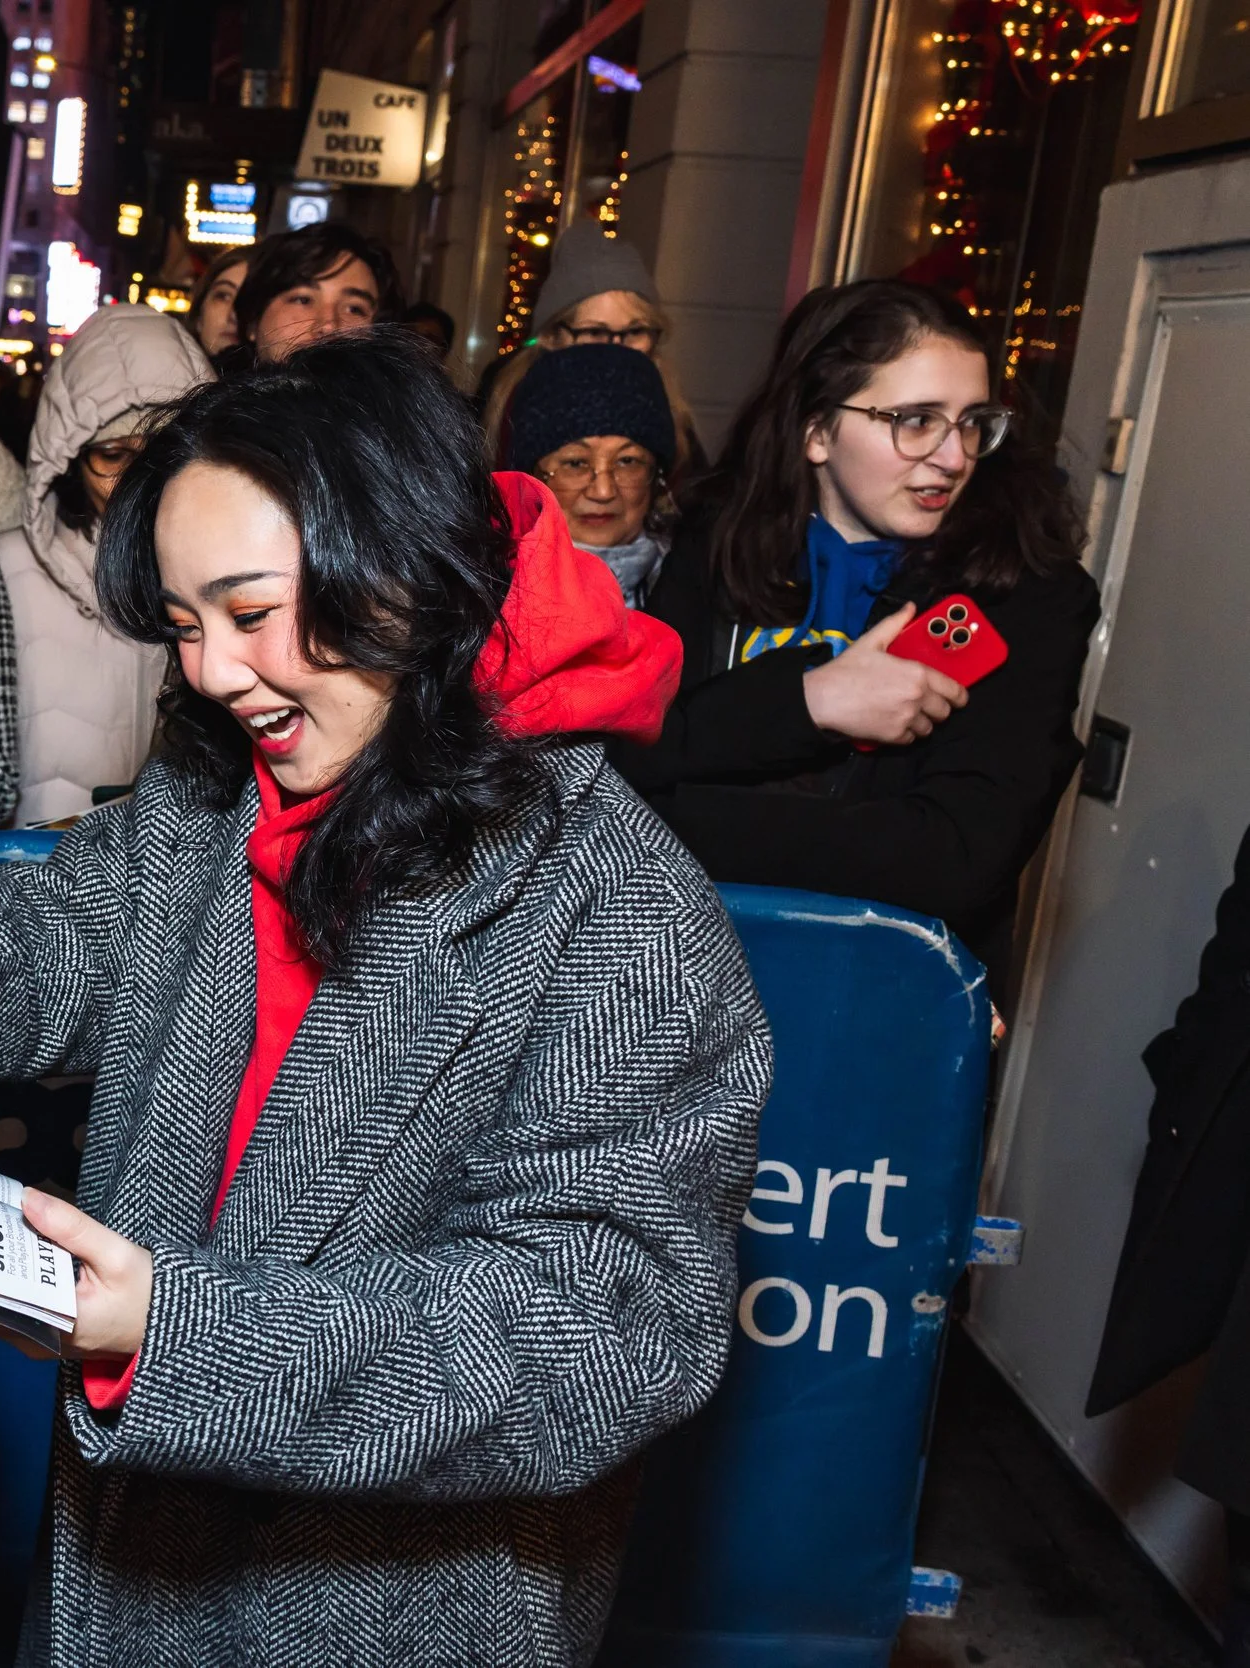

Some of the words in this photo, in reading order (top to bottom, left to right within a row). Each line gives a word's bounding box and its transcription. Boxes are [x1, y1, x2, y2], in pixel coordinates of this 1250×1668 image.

[317, 109, 349, 129] UN
[325, 134, 384, 155] DEUX
[312, 156, 381, 178] TROIS
[16, 1242, 29, 1264] Playbill
